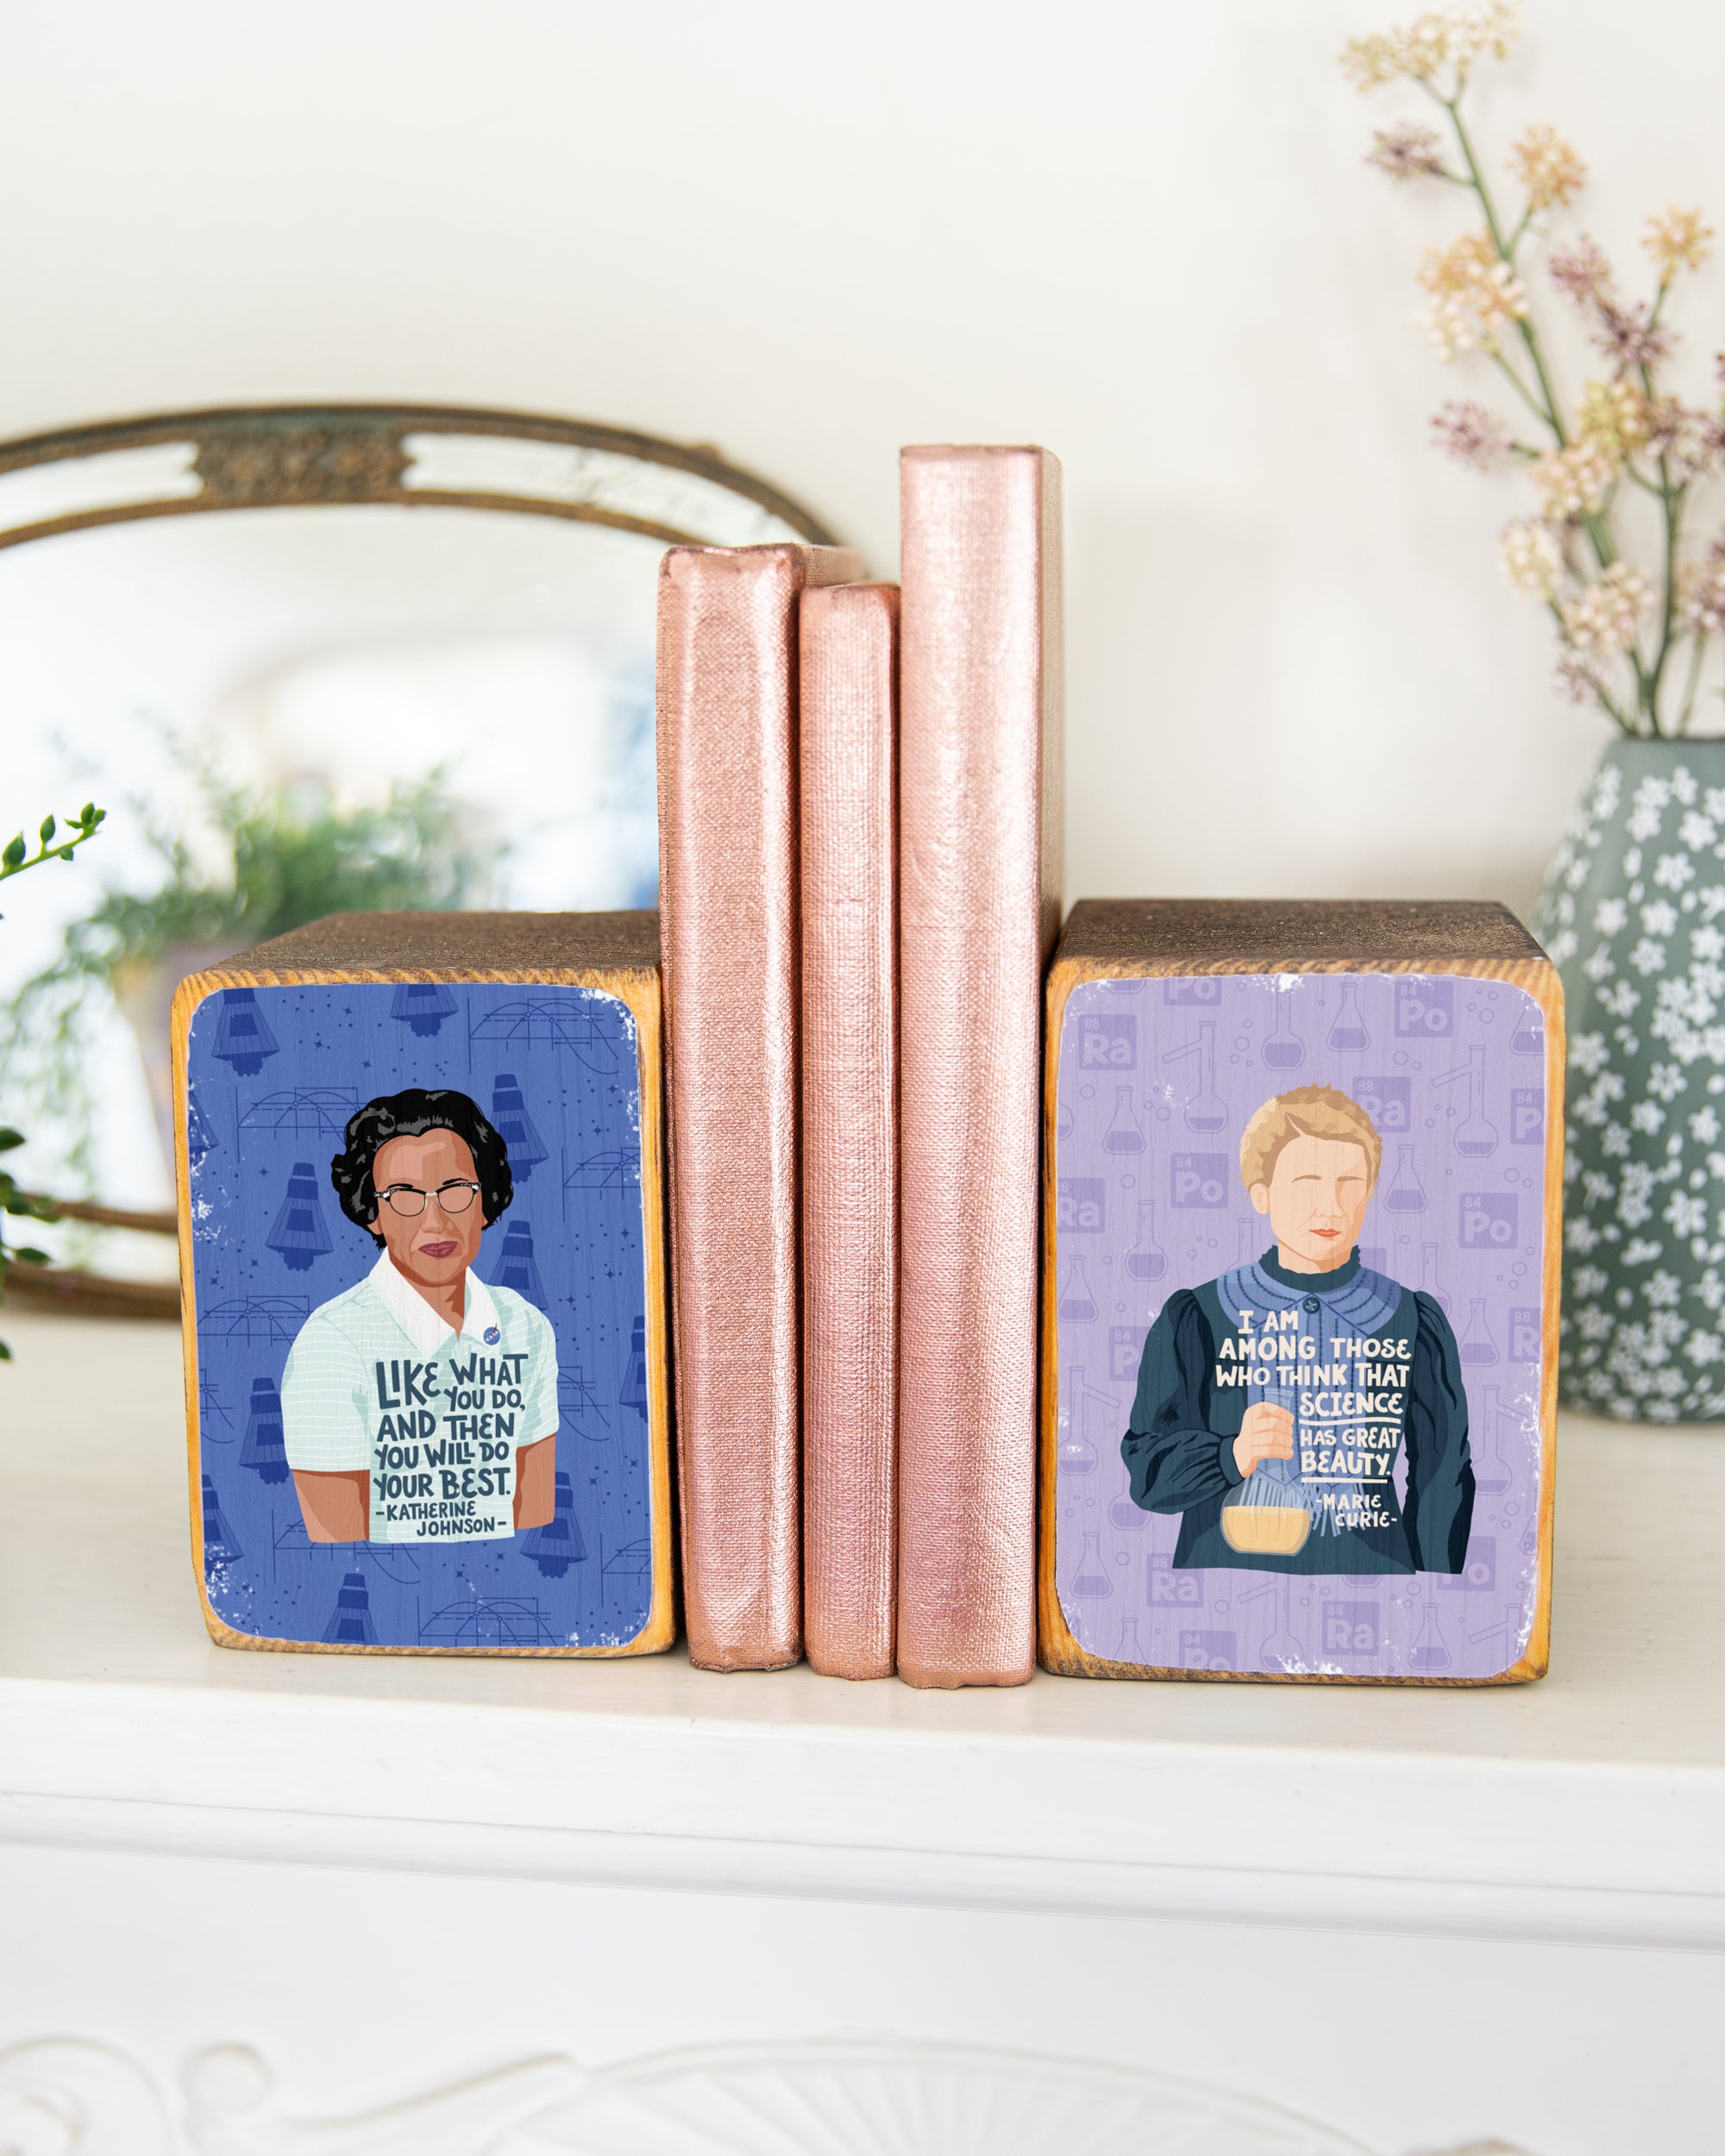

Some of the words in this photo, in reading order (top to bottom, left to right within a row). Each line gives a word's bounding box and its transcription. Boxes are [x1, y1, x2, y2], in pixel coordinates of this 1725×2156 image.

[1400, 986, 1416, 996] 84
[1084, 1018, 1101, 1030] 88
[1399, 999, 1448, 1031] Po
[1083, 1033, 1132, 1064] Ra
[1358, 1081, 1374, 1092] 88
[1517, 1093, 1533, 1104] 84
[1358, 1094, 1406, 1126] Ra
[1516, 1107, 1544, 1138] P
[1176, 1157, 1192, 1168] 84
[1176, 1171, 1224, 1202] Po
[1057, 1196, 1100, 1226] Ra
[1465, 1197, 1481, 1207] 84
[1464, 1211, 1513, 1243] Po
[1238, 1310, 1254, 1334] I
[1264, 1310, 1299, 1332] AM
[1515, 1312, 1530, 1323] 88
[1115, 1331, 1131, 1341] 84
[1219, 1336, 1316, 1361] AMONG
[1330, 1338, 1412, 1359] THOSE
[376, 1359, 441, 1409] LIKE
[448, 1353, 529, 1386] WHAT
[1215, 1364, 1270, 1387] WHO
[1276, 1363, 1348, 1386] THINK
[1355, 1363, 1410, 1387] THAT
[443, 1386, 485, 1412] YOU
[492, 1389, 525, 1412] DO,
[1299, 1392, 1403, 1417] SCIENCE
[377, 1409, 436, 1442] AND
[442, 1413, 515, 1440] THEN
[1301, 1428, 1337, 1447] HAS
[1342, 1426, 1402, 1449] GREAT
[374, 1444, 419, 1470] YOU
[423, 1439, 474, 1468] WILL
[479, 1441, 510, 1462] DO
[1301, 1450, 1392, 1476] BEAUTY.
[373, 1473, 435, 1501] YOUR
[439, 1467, 511, 1500] BEST.
[376, 1501, 476, 1521] -KATHERINE
[1315, 1494, 1382, 1510] -MARIE
[1335, 1511, 1397, 1527] CURIE-
[1152, 1557, 1168, 1568] 88
[1151, 1571, 1199, 1601] Ra
[1185, 1634, 1201, 1645] 84
[1327, 1619, 1374, 1649] Ra
